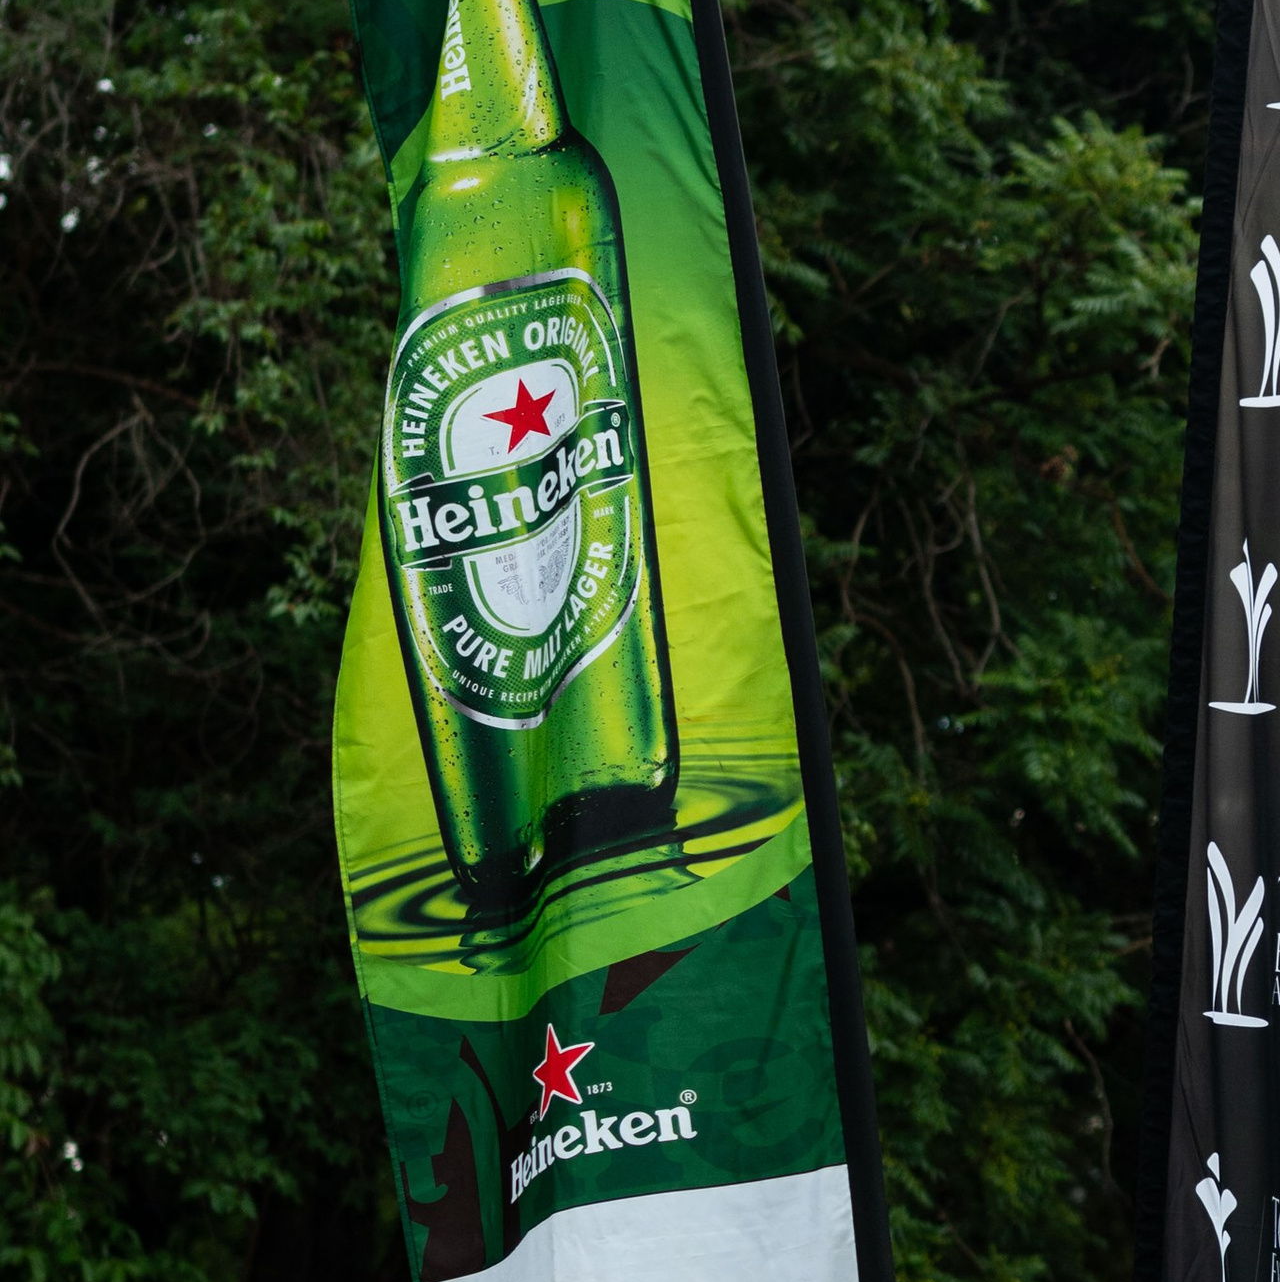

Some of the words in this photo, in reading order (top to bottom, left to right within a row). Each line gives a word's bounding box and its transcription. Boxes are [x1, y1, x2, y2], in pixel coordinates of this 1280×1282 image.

[406, 323, 459, 368] PREMIUM
[464, 302, 528, 328] QUALITY
[401, 330, 511, 458] HEINEKEN
[523, 315, 599, 387] ORIGINAL
[397, 428, 624, 553] Heineken
[593, 506, 615, 518] MARK
[428, 583, 453, 596] TRADE
[442, 614, 515, 679] PURE
[523, 622, 562, 680] MALT
[562, 541, 614, 633] LAGER
[452, 669, 495, 699] UNIQUE
[500, 689, 539, 703] RECIPE
[586, 1081, 613, 1095] 1873
[510, 1106, 698, 1205] Heineken
